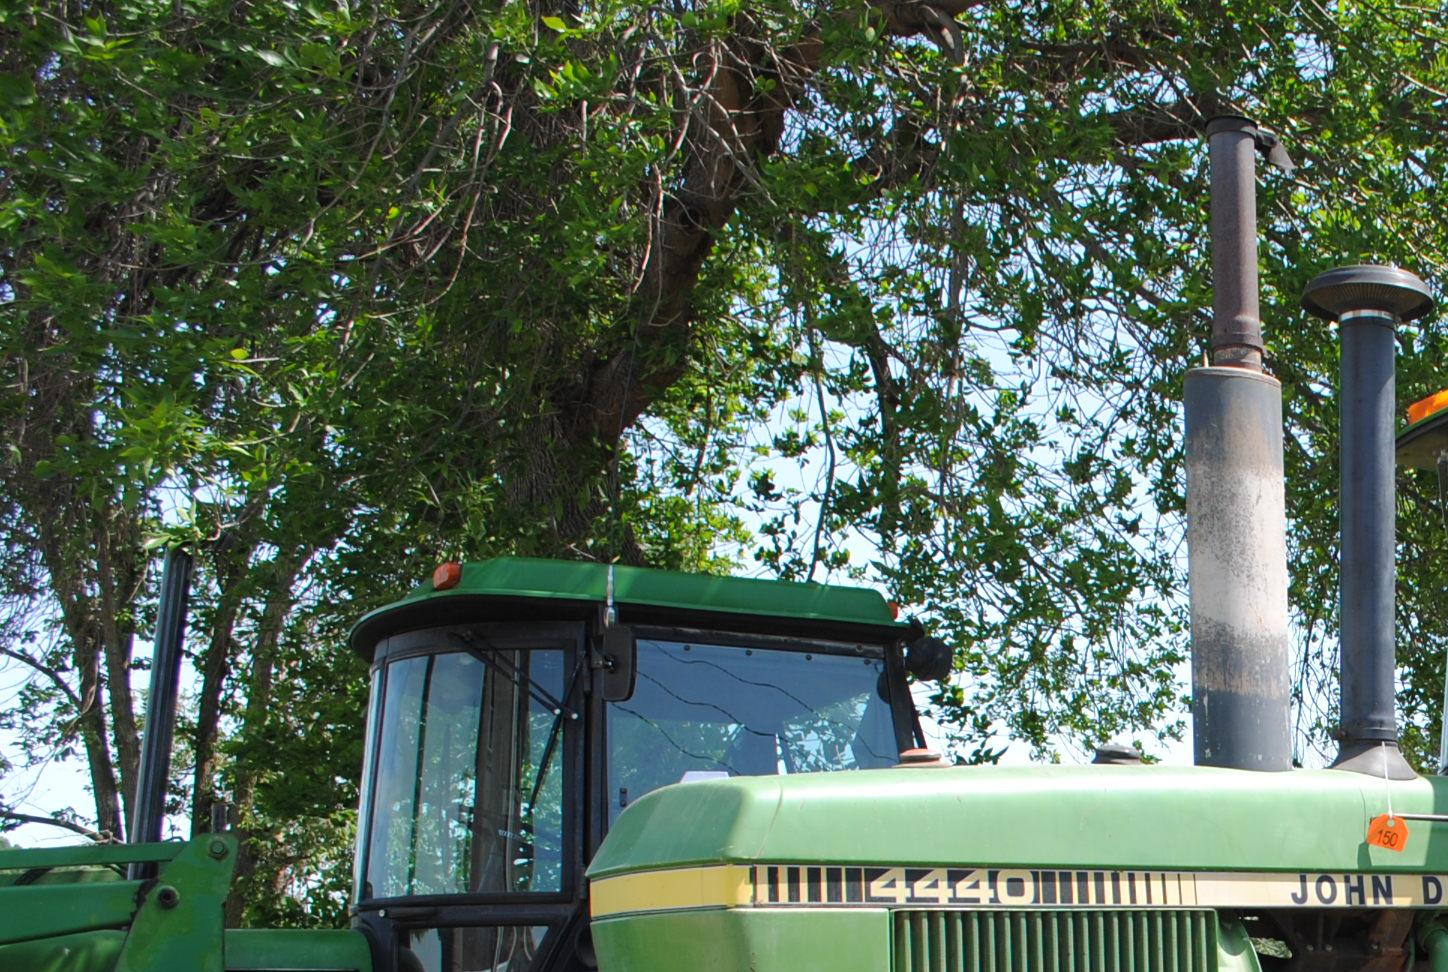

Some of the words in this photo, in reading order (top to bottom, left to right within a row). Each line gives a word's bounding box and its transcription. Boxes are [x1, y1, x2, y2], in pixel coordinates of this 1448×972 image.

[1375, 829, 1399, 847] 150
[870, 868, 1035, 905] 4440
[1291, 874, 1393, 905] JOHN
